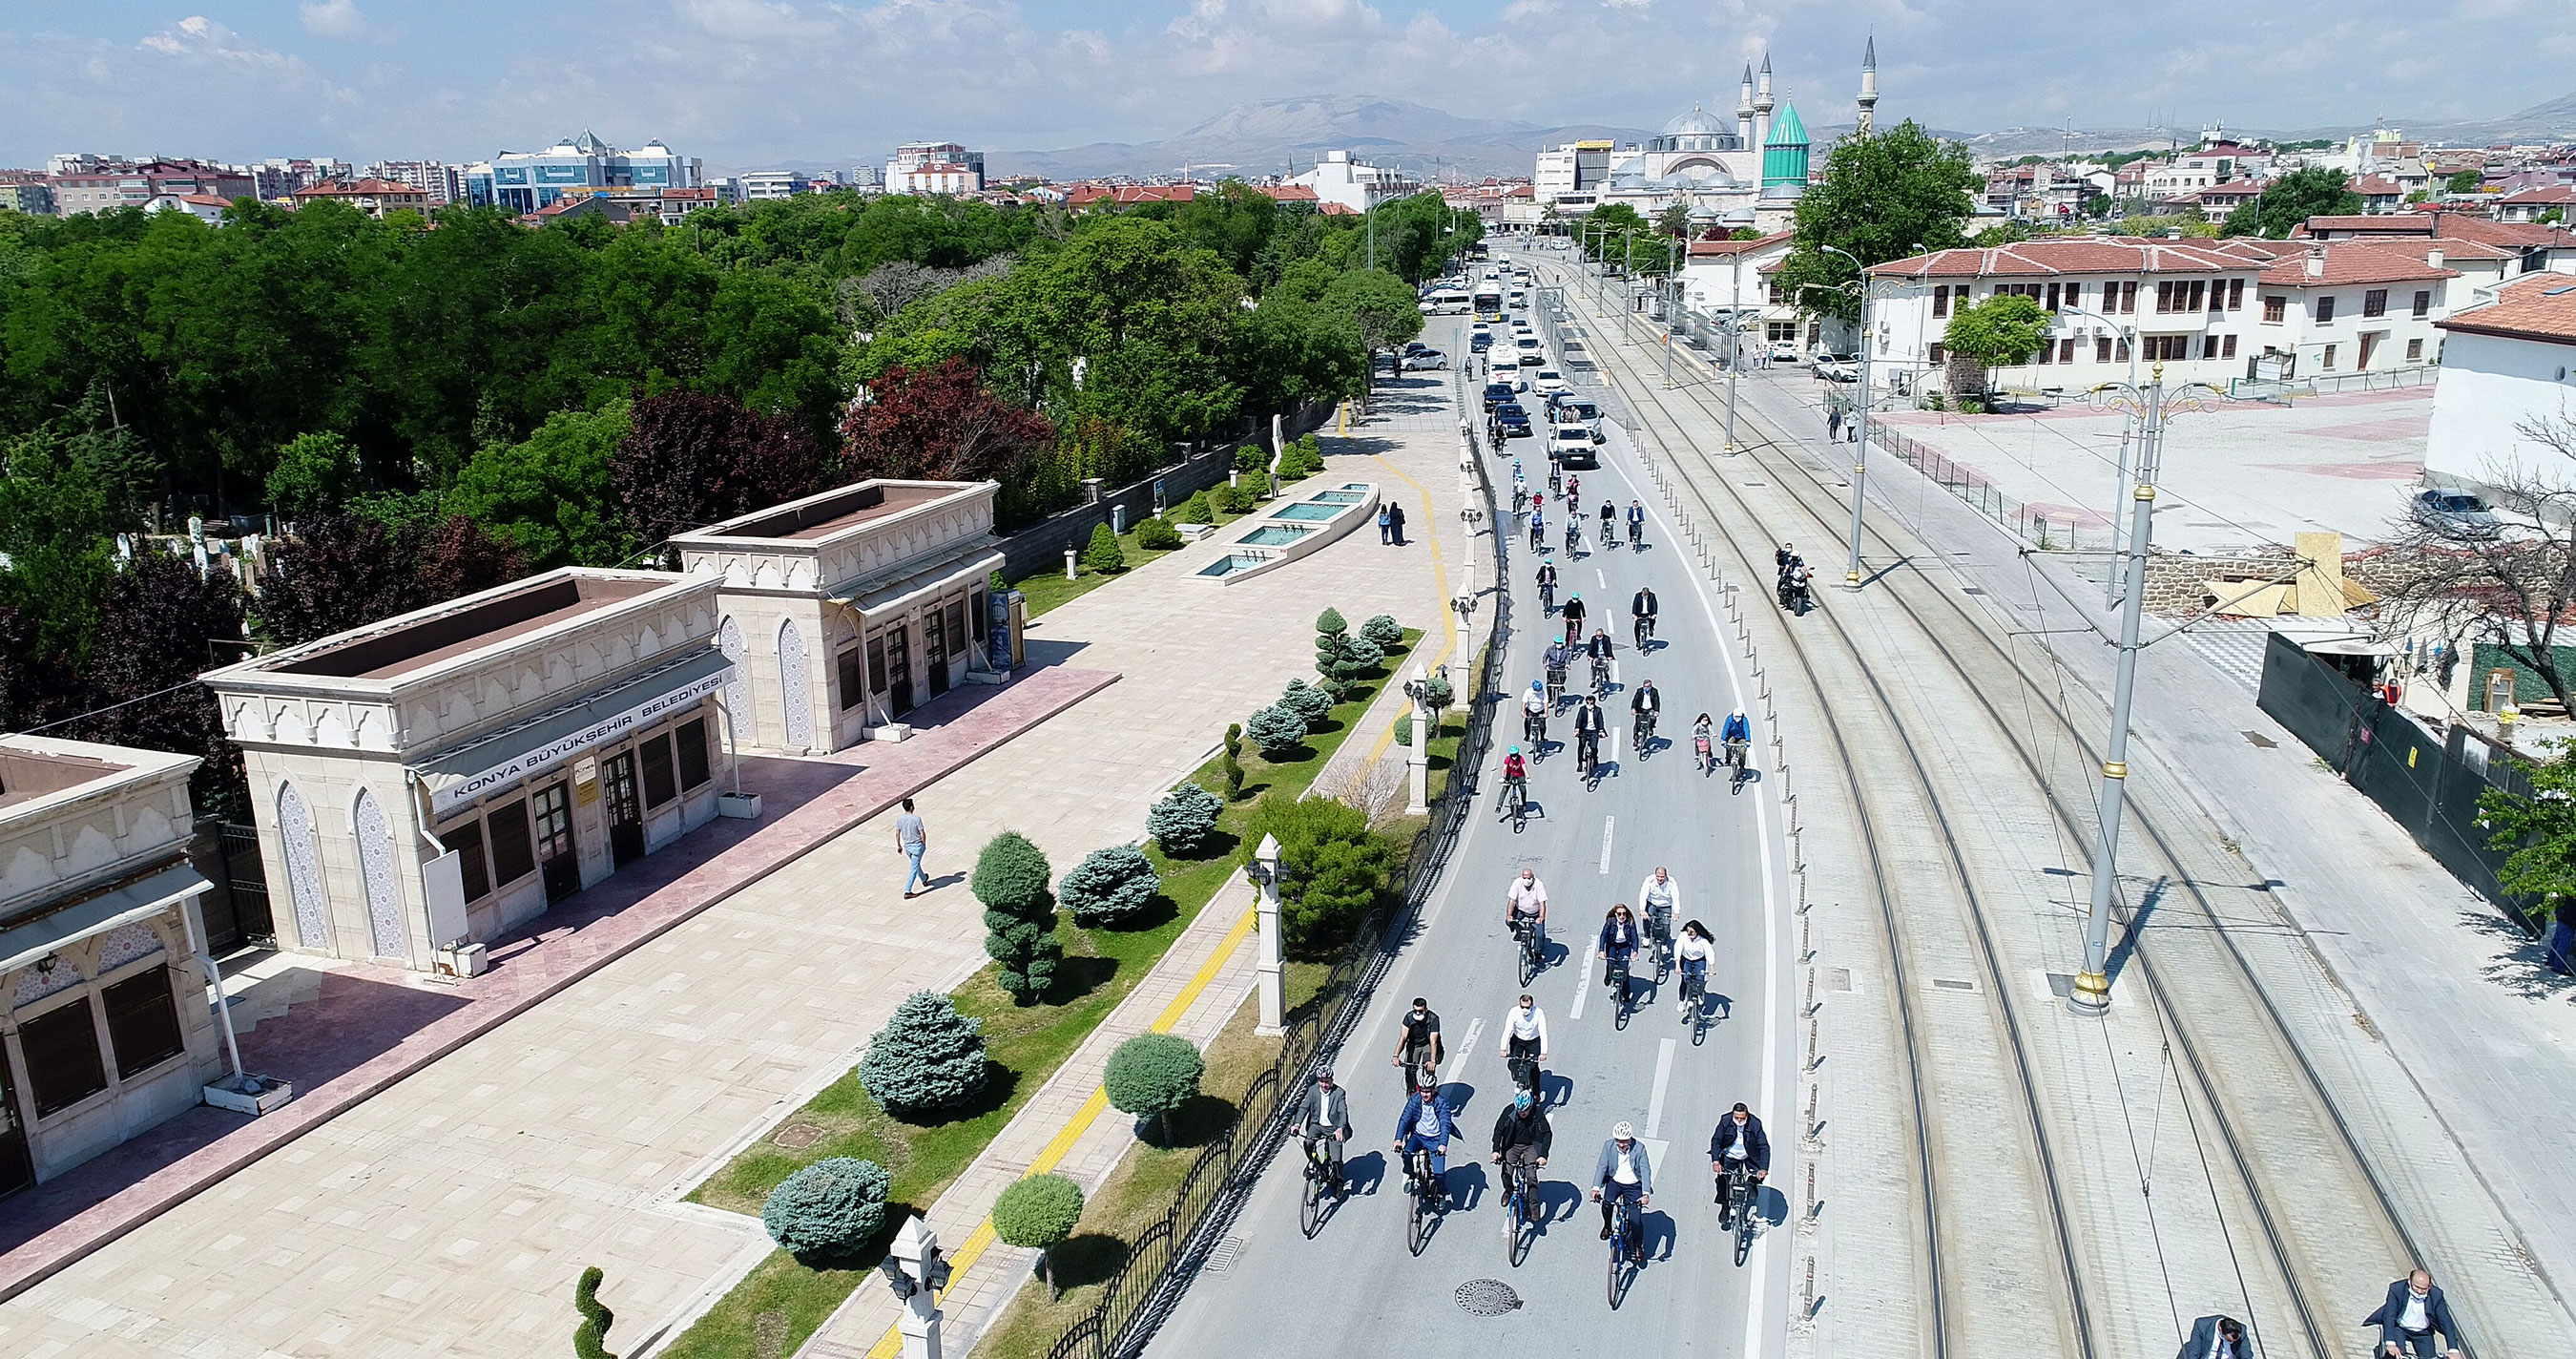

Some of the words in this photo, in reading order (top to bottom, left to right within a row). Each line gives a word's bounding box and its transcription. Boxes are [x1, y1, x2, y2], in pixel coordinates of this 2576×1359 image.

[454, 764, 521, 799] KONYA
[526, 716, 633, 767] BÜYÜKŞEHİR
[642, 674, 723, 718] BELEDİYESİ
